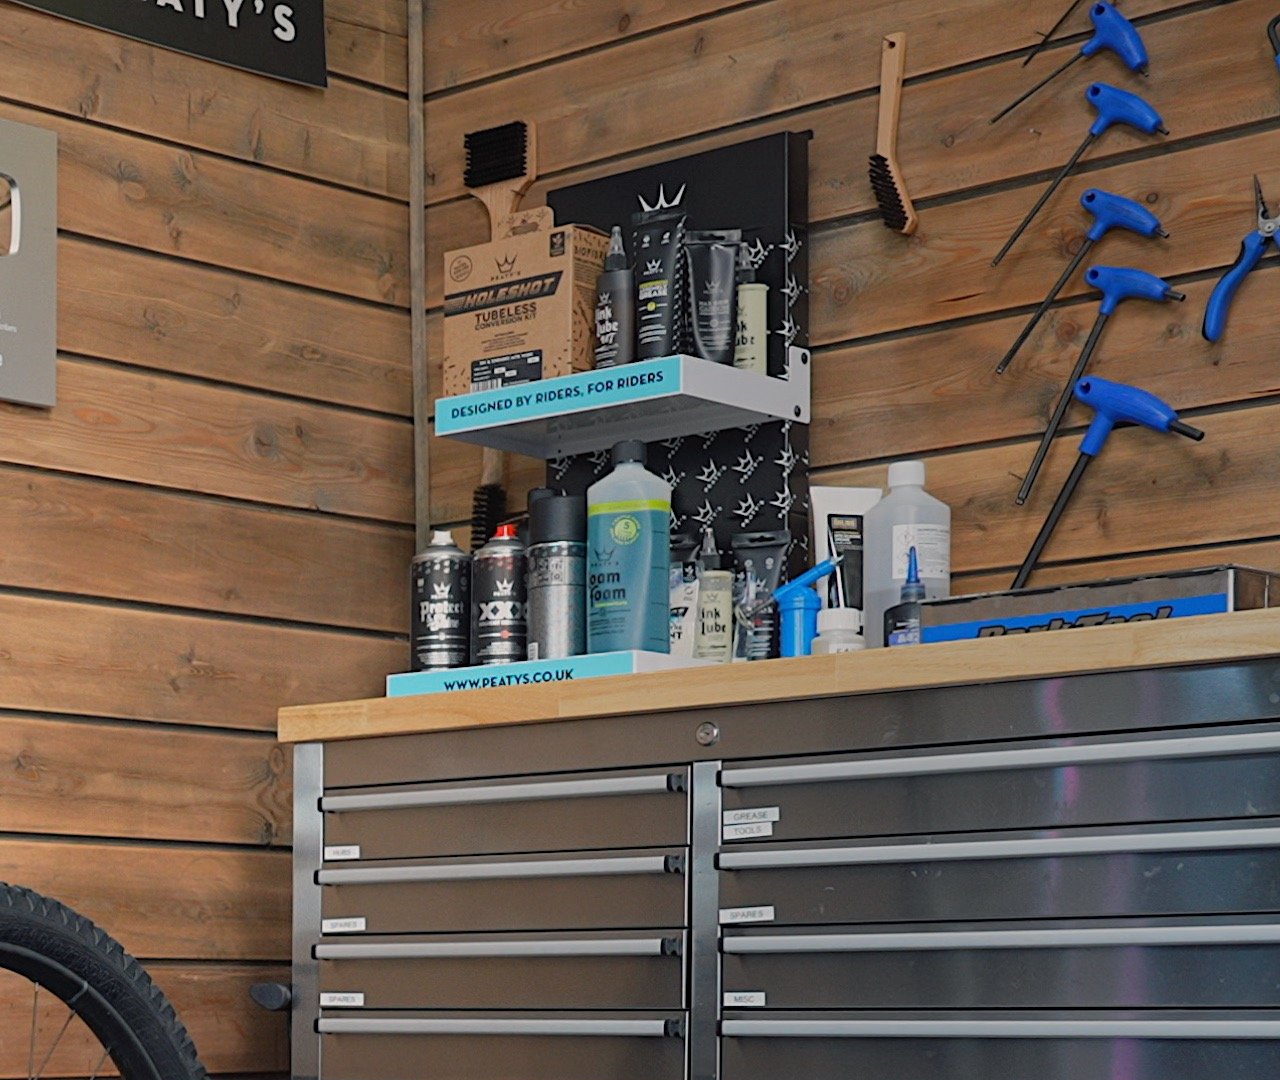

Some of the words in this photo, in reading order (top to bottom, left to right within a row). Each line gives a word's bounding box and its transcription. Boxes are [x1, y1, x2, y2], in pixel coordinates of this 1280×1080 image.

[462, 276, 557, 308] HOLESHOT
[474, 316, 523, 331] CONVERSION
[524, 312, 537, 322] KIT
[475, 302, 537, 323] TUBELESS
[451, 398, 513, 419] DESIGNED
[515, 394, 533, 408] BY
[535, 385, 585, 404] RIDERS,
[587, 379, 614, 395] FOR
[617, 370, 665, 389] RIDERS
[589, 572, 621, 586] oam
[589, 585, 626, 608] foam
[701, 621, 726, 636] lube
[443, 668, 574, 692] WWW.PEATYS.CO.UK
[734, 811, 769, 821] GREASE
[734, 825, 762, 836] TOOLS
[729, 910, 764, 919] SPARES
